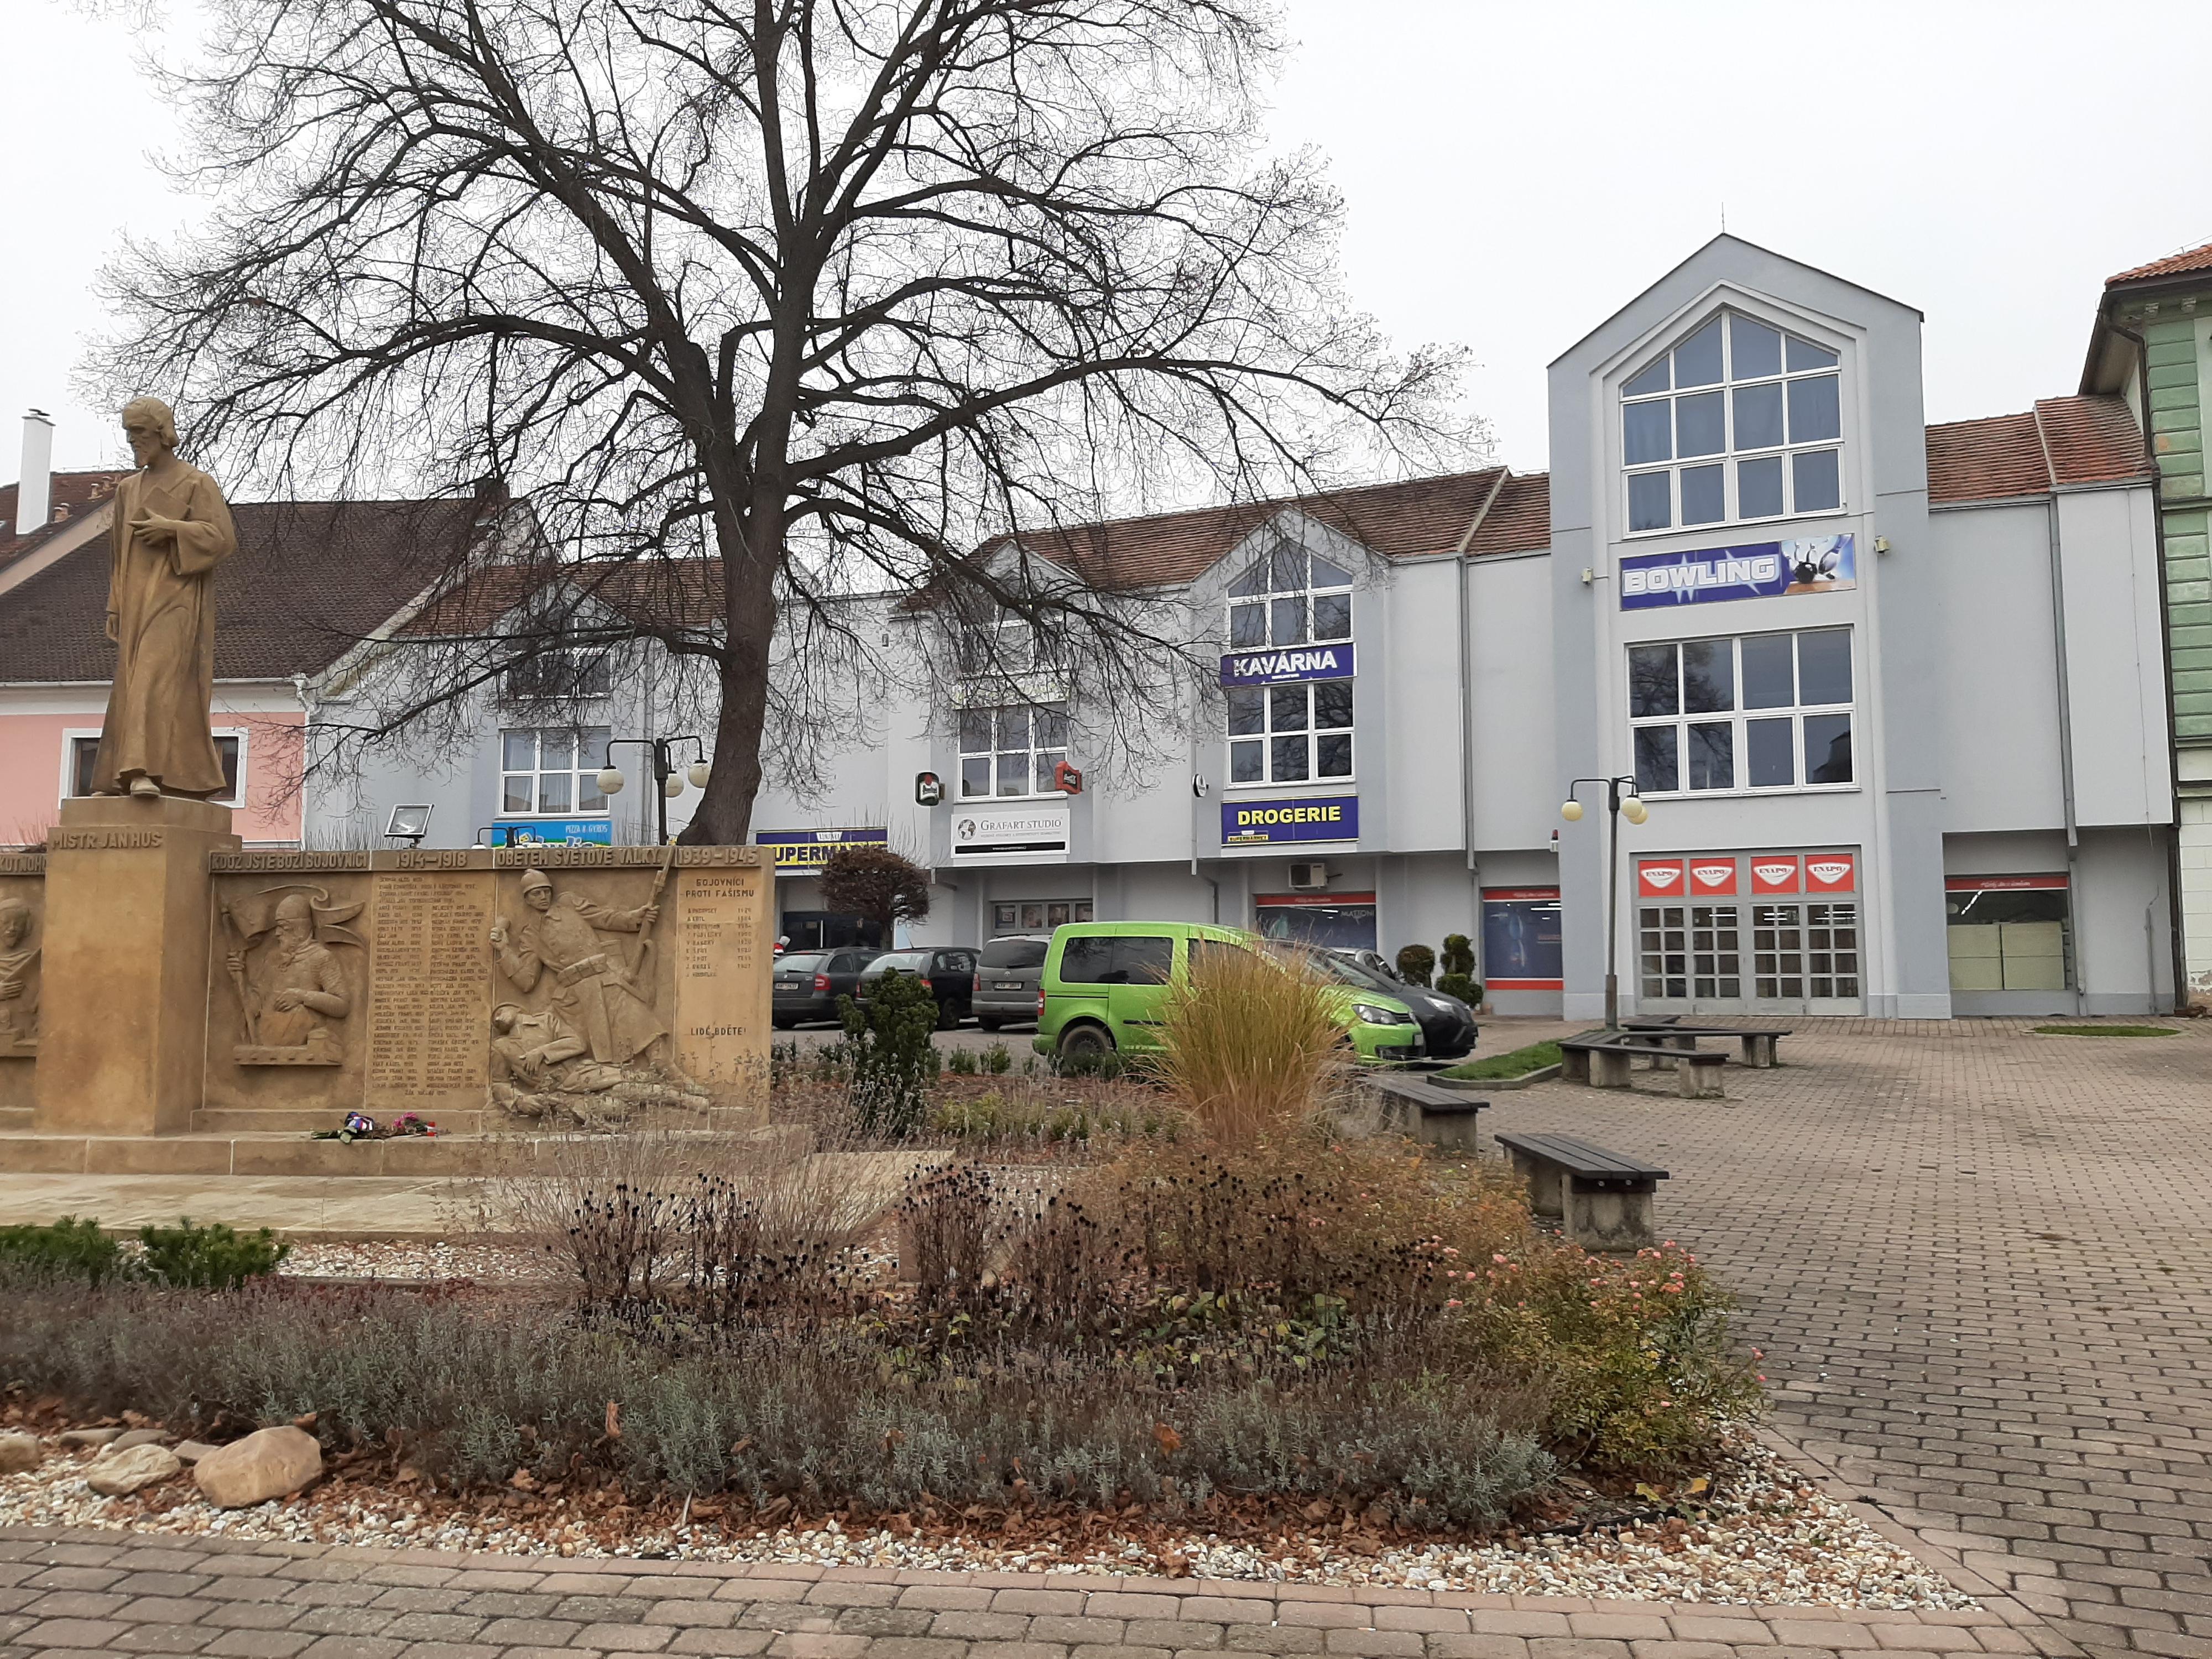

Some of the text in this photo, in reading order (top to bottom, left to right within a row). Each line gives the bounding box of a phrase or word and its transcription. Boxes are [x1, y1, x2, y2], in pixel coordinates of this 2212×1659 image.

[1624, 557, 1775, 593] BOWLING
[1234, 650, 1338, 677] KAVÁRNA
[1027, 819, 1062, 829] STUDIO
[1237, 805, 1341, 826] DROGERIE
[566, 825, 581, 833] PIZZA
[52, 831, 164, 849] MISTR JAN HUS
[246, 853, 275, 870] JSTE
[686, 888, 754, 898] PROTI FAŠISMU
